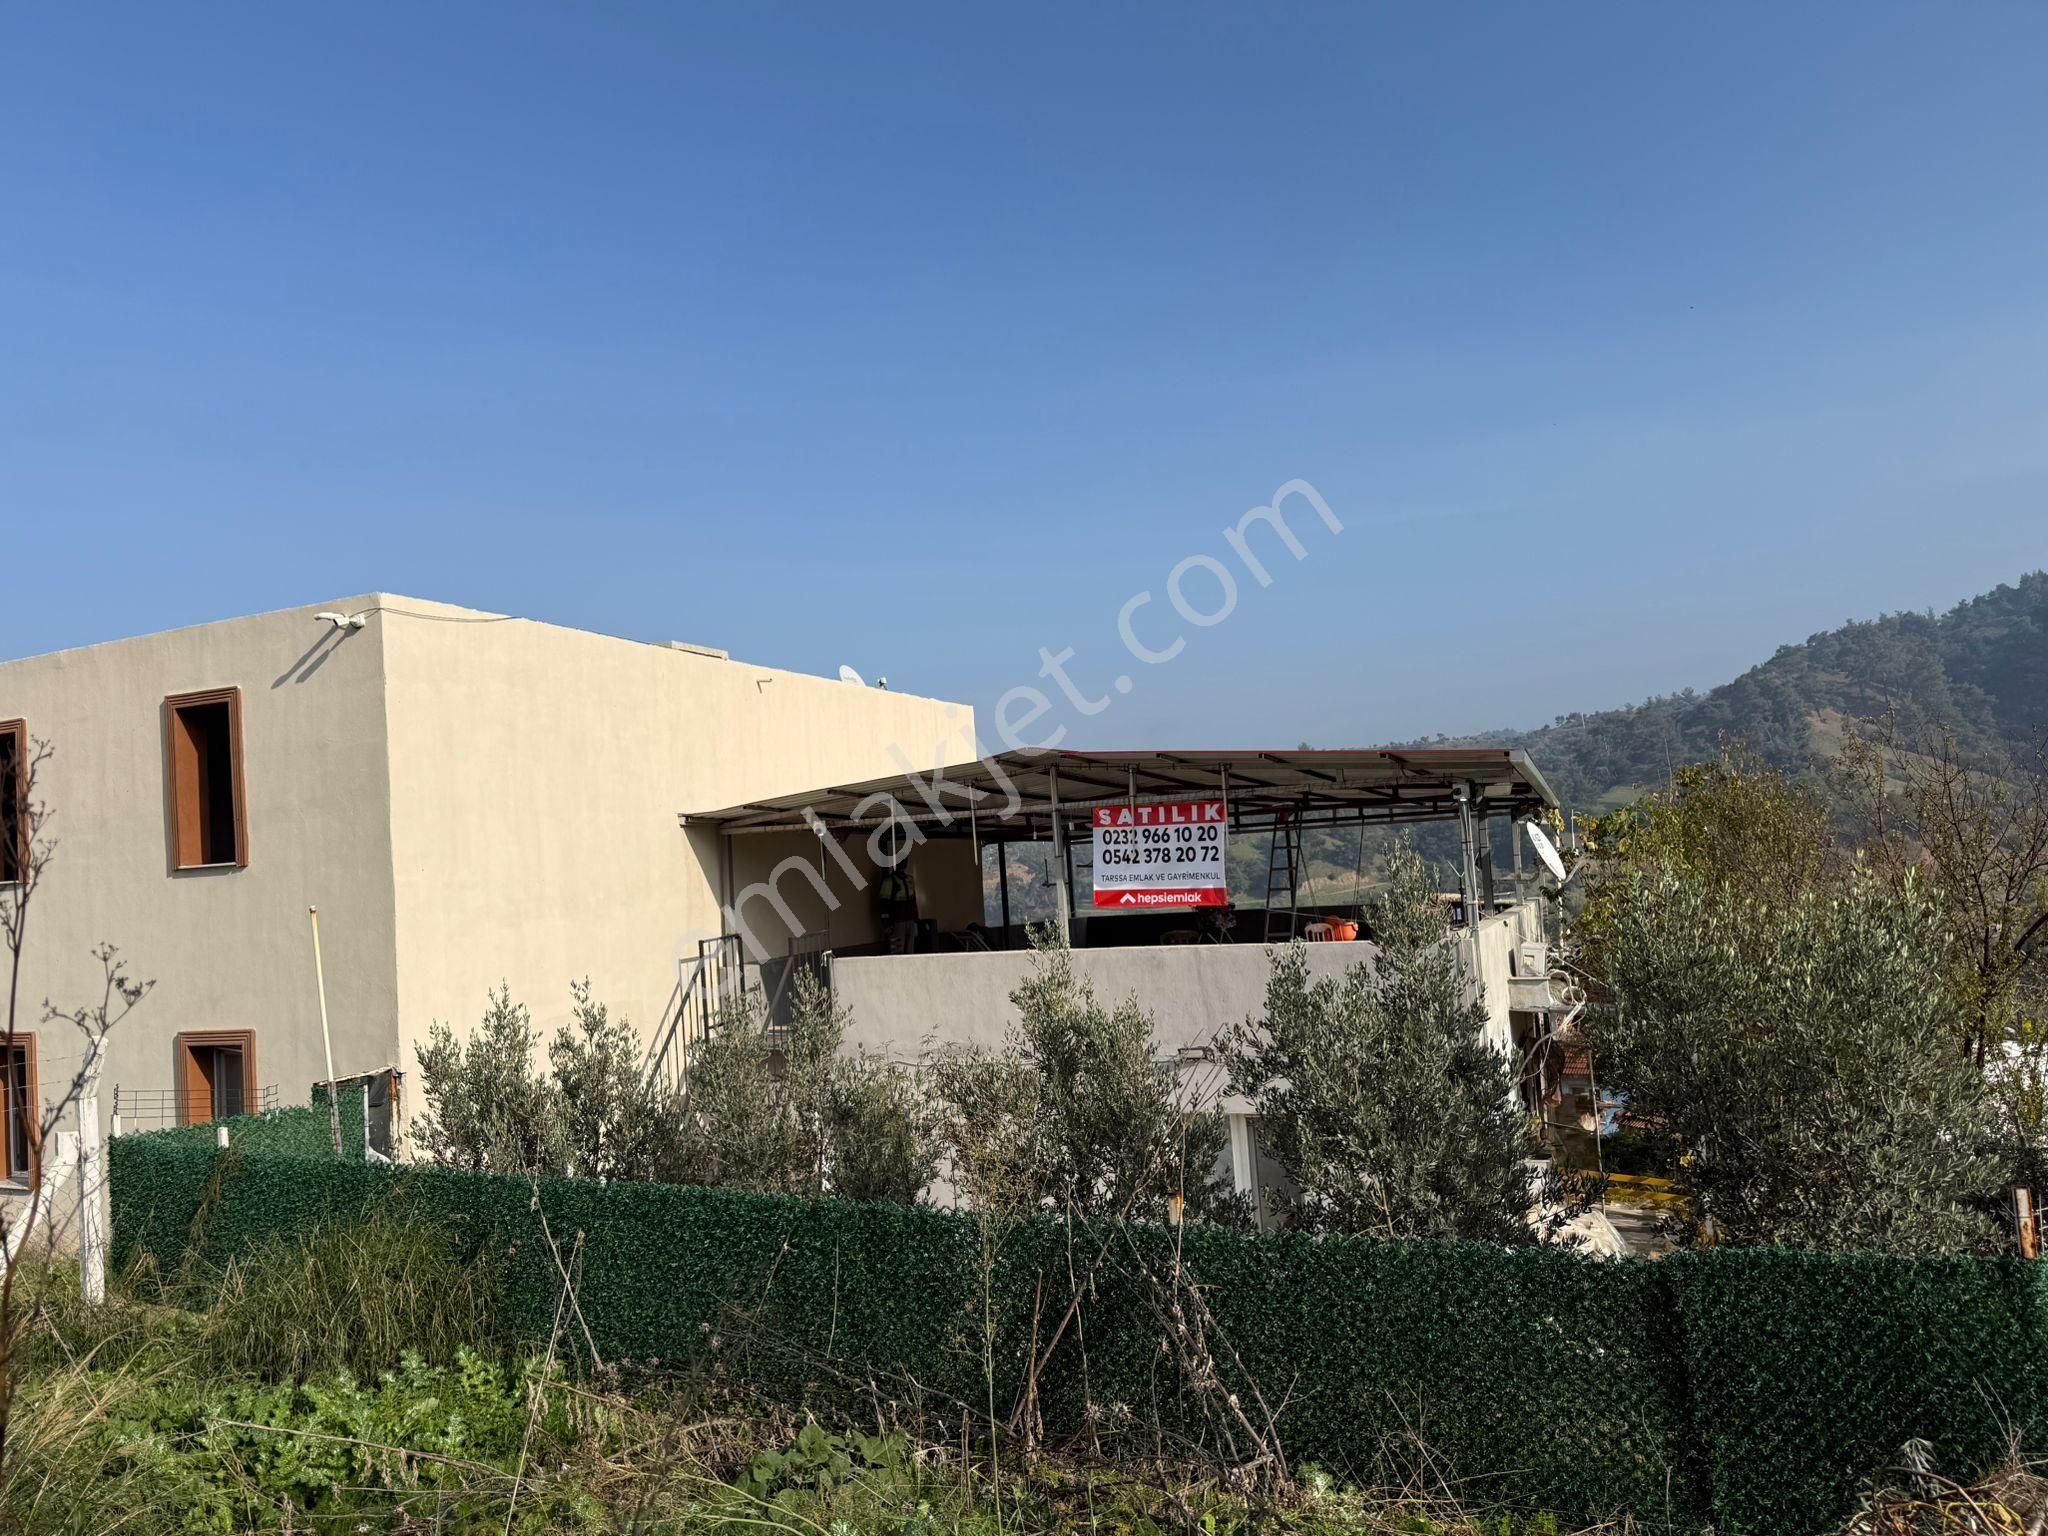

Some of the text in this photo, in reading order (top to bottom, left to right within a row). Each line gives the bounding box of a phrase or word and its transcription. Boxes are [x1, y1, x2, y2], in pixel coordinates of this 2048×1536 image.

[1098, 804, 1221, 826] SATILIK
[1102, 826, 1218, 845] 0232 966 10 20
[1102, 846, 1219, 865] 0542 378 20 72
[1101, 871, 1221, 883] TARSSA EMLAK VE GAYRİMENKUL
[1137, 892, 1202, 905] hepsiemlak
